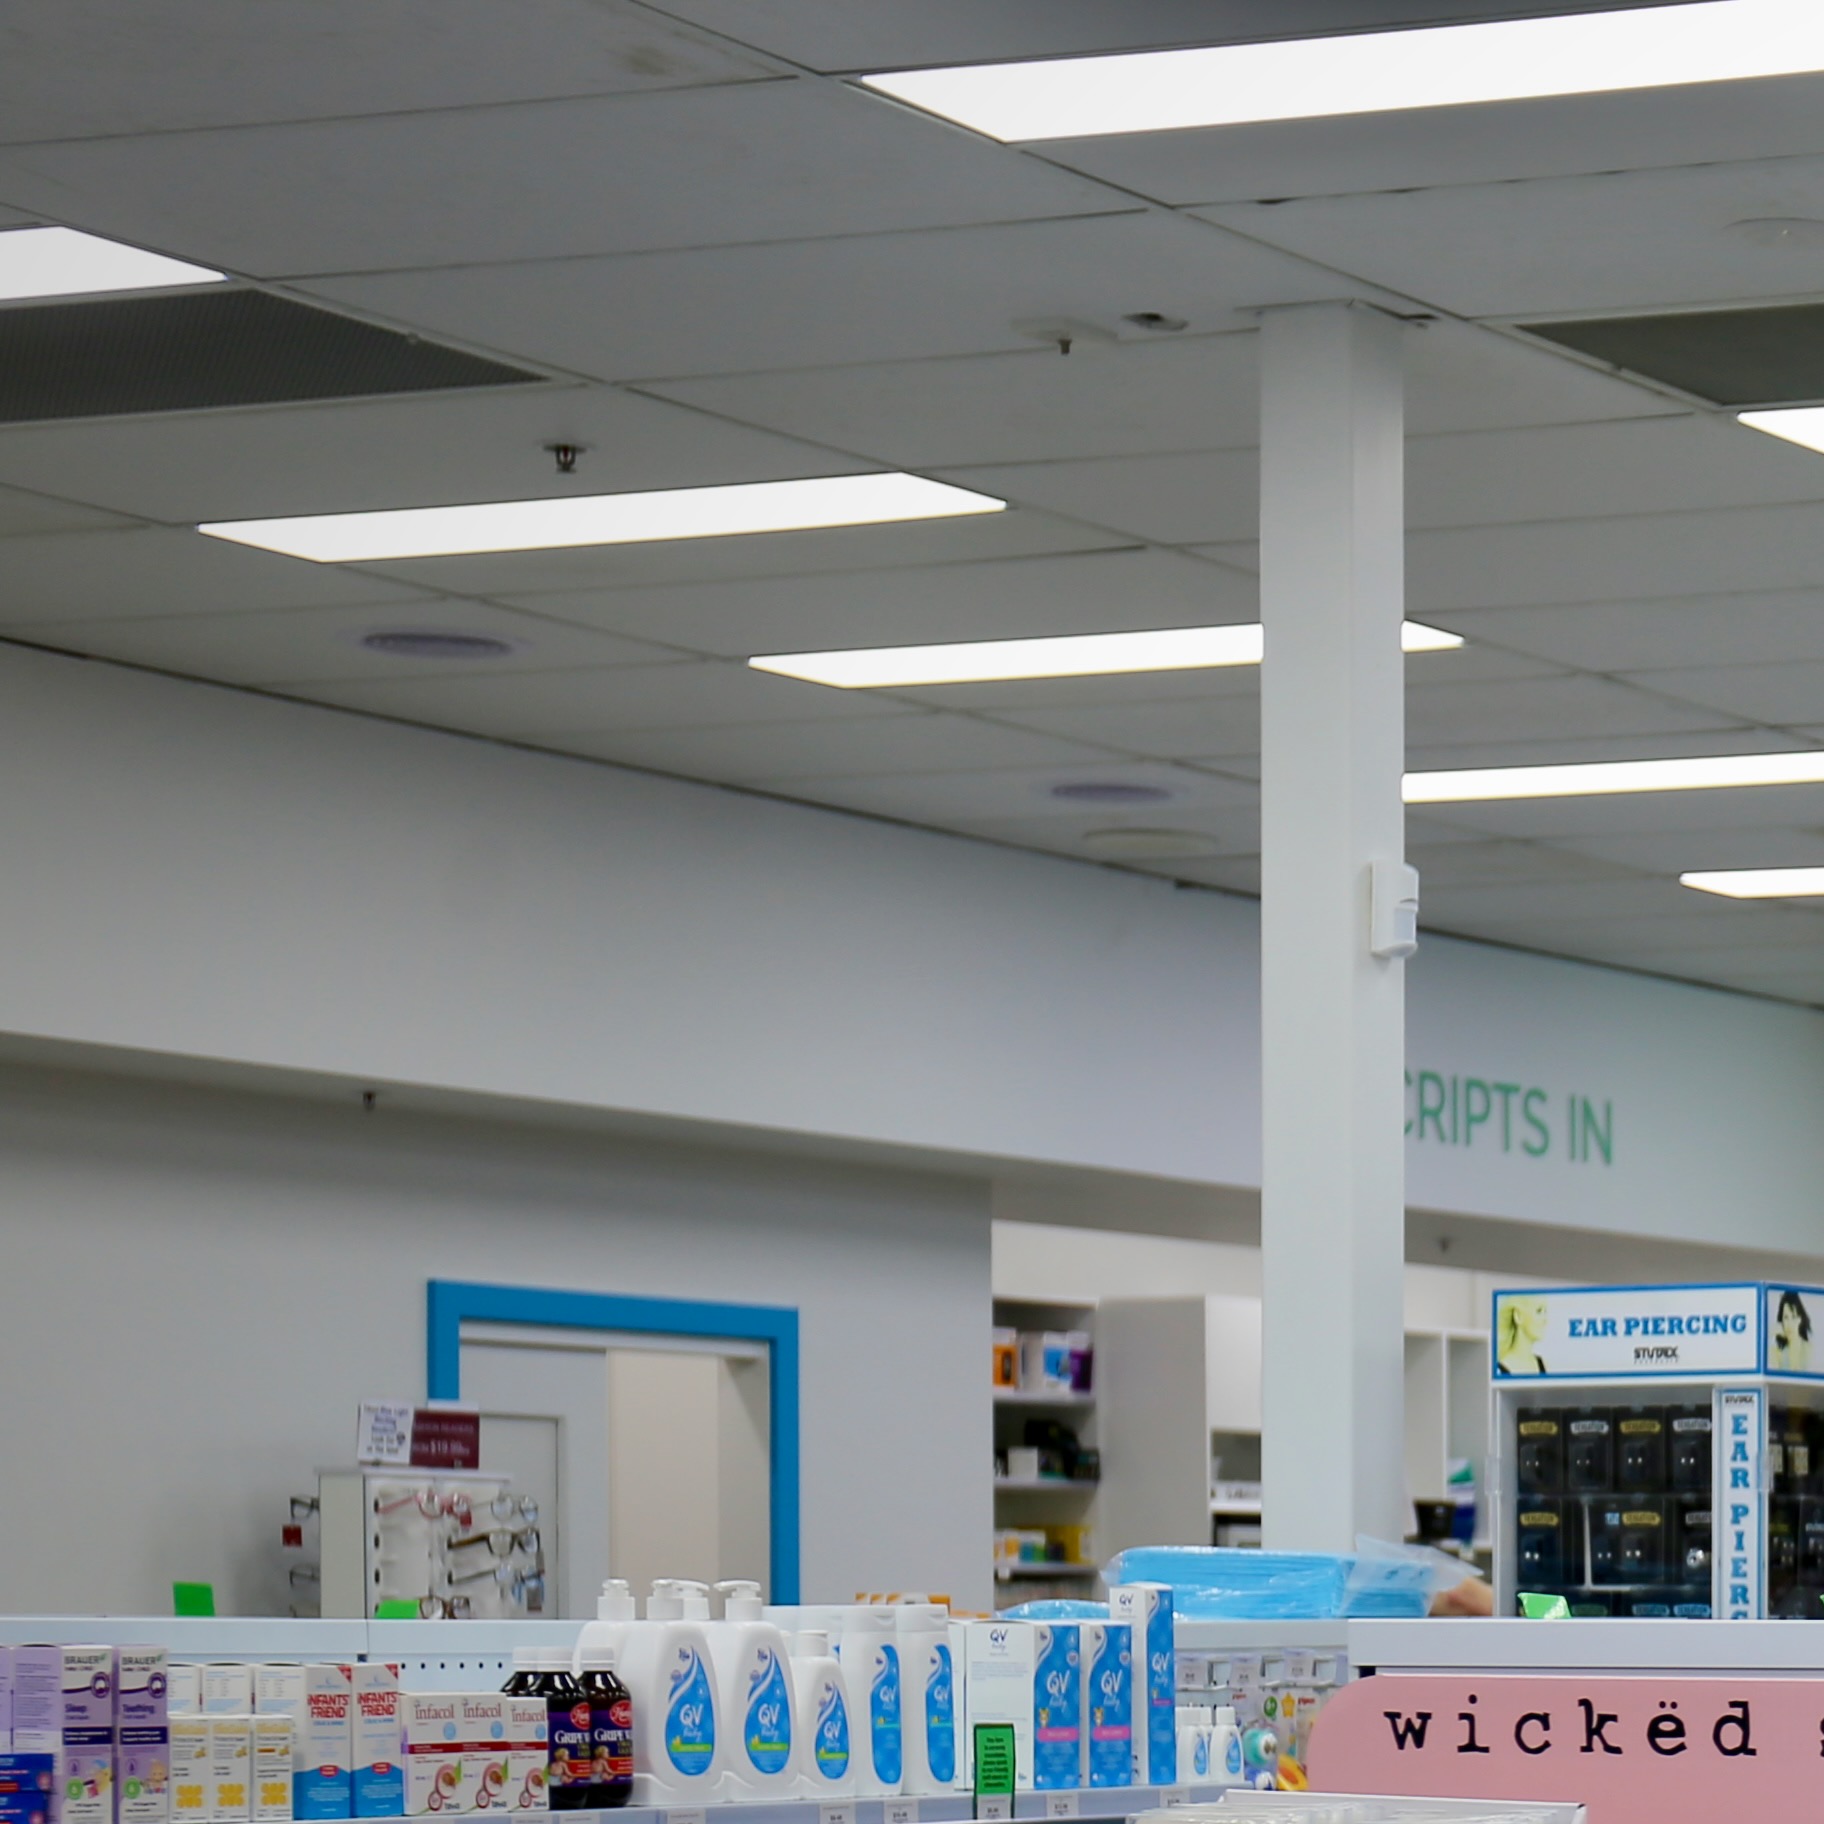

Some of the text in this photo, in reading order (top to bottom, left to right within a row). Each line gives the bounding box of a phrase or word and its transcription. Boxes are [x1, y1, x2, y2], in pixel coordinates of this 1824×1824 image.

[1569, 1092, 1613, 1165] IN
[1568, 1314, 1747, 1338] EAR PIERCING
[64, 1655, 99, 1665] BRAUER
[122, 1656, 156, 1666] BRAUER
[1046, 1671, 1069, 1697] QV
[65, 1704, 87, 1714] Sleep
[122, 1704, 155, 1714] Teething
[311, 1705, 346, 1719] FRIEND
[361, 1704, 395, 1717] FRIEND
[415, 1704, 455, 1720] infacol
[463, 1701, 502, 1719] infacol
[679, 1703, 703, 1726] QV
[758, 1704, 780, 1727] QV
[1383, 1695, 1758, 1761] wickëd
